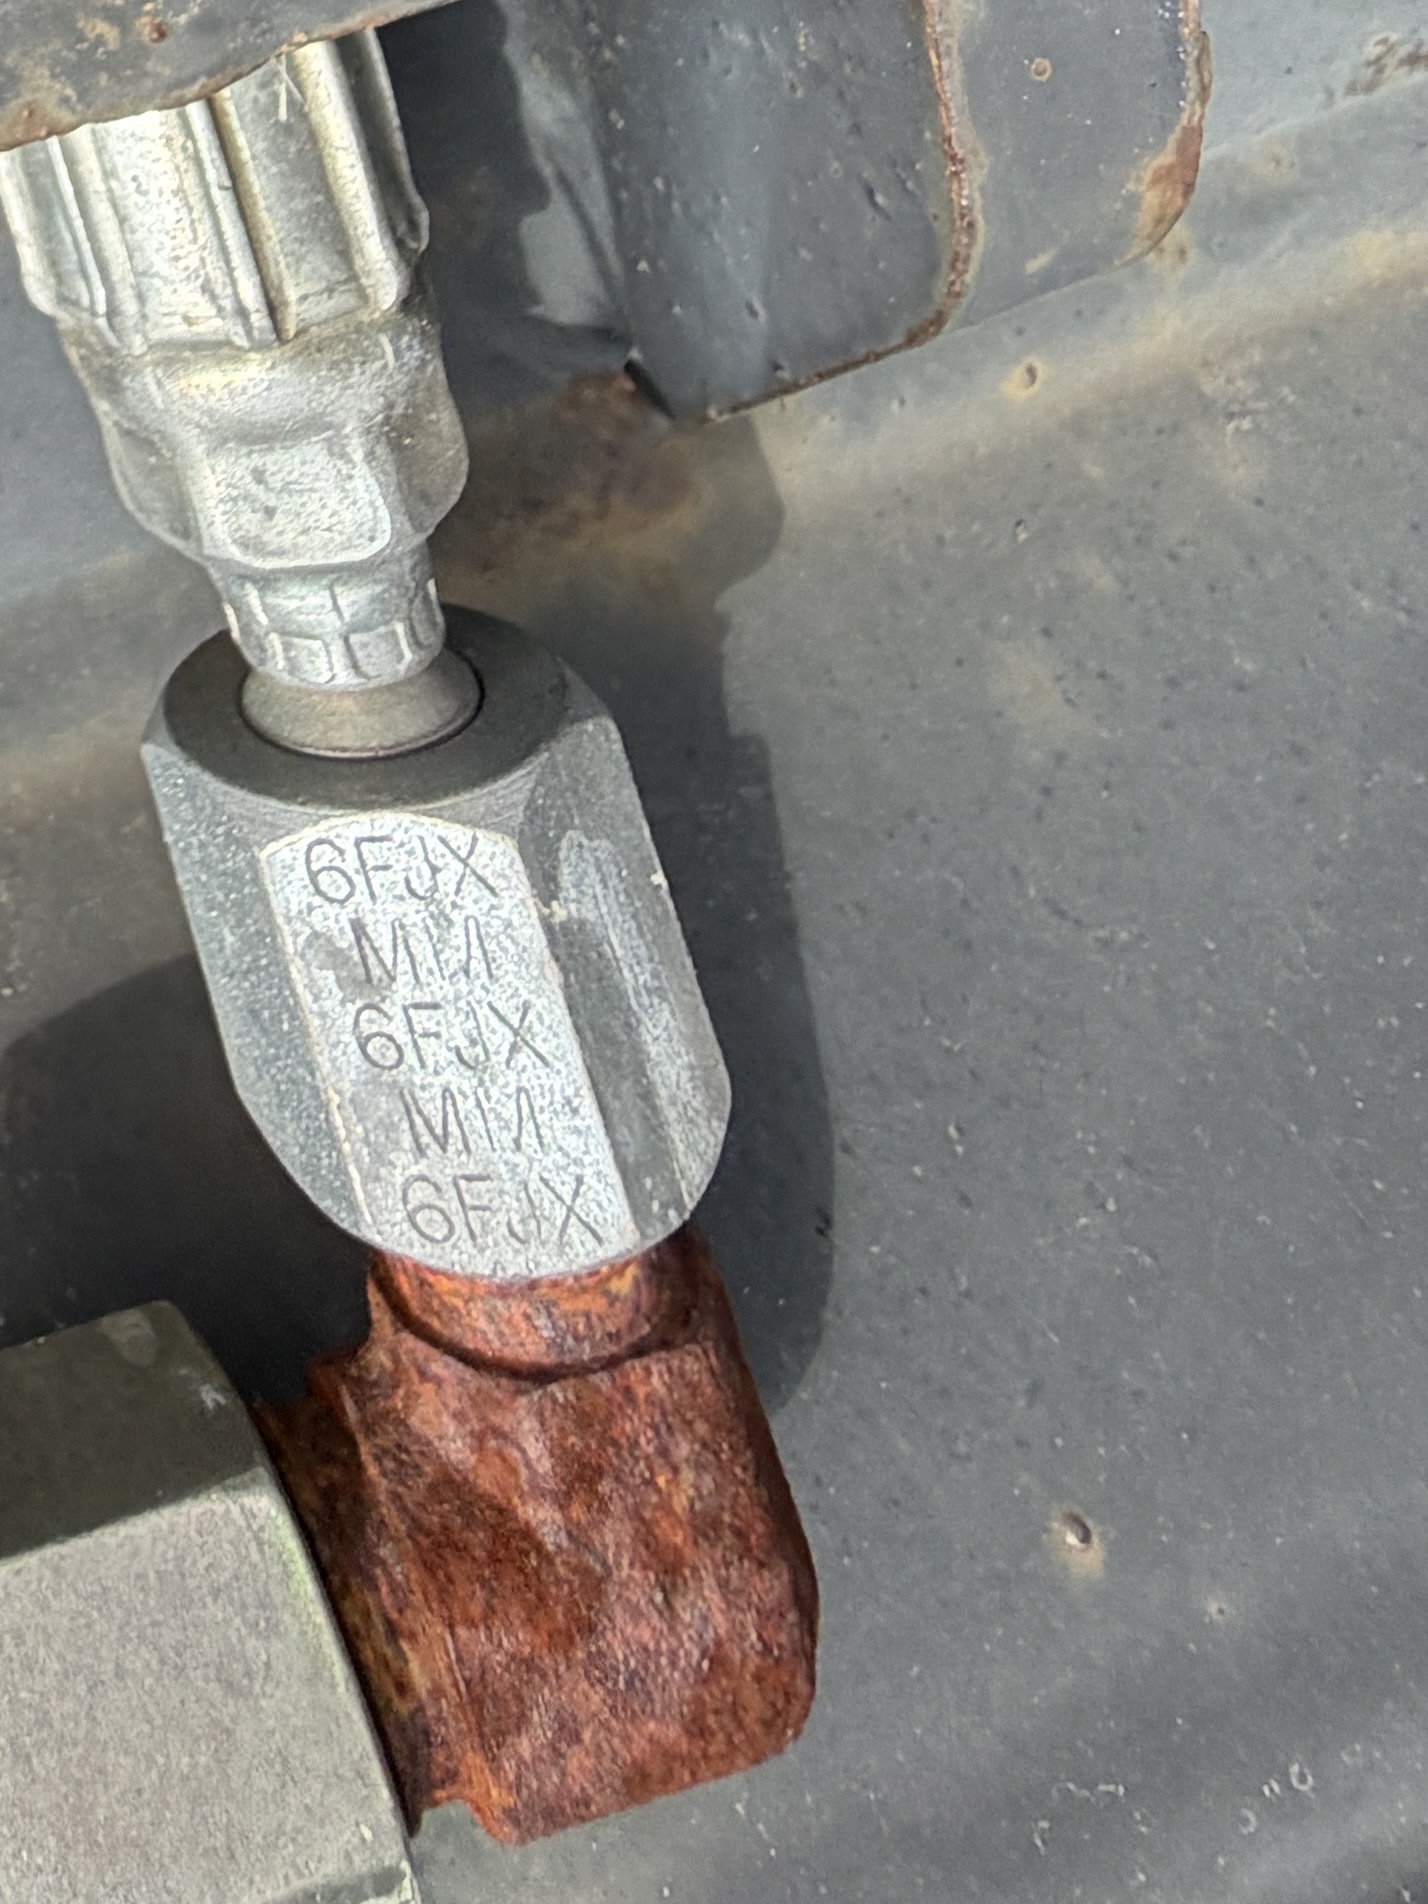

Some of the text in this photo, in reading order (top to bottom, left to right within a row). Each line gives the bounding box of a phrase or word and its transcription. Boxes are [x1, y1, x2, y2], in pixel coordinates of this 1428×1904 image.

[304, 833, 498, 904] 6FJX
[352, 998, 550, 1072] 6FJX
[401, 1170, 604, 1248] 6FJX
